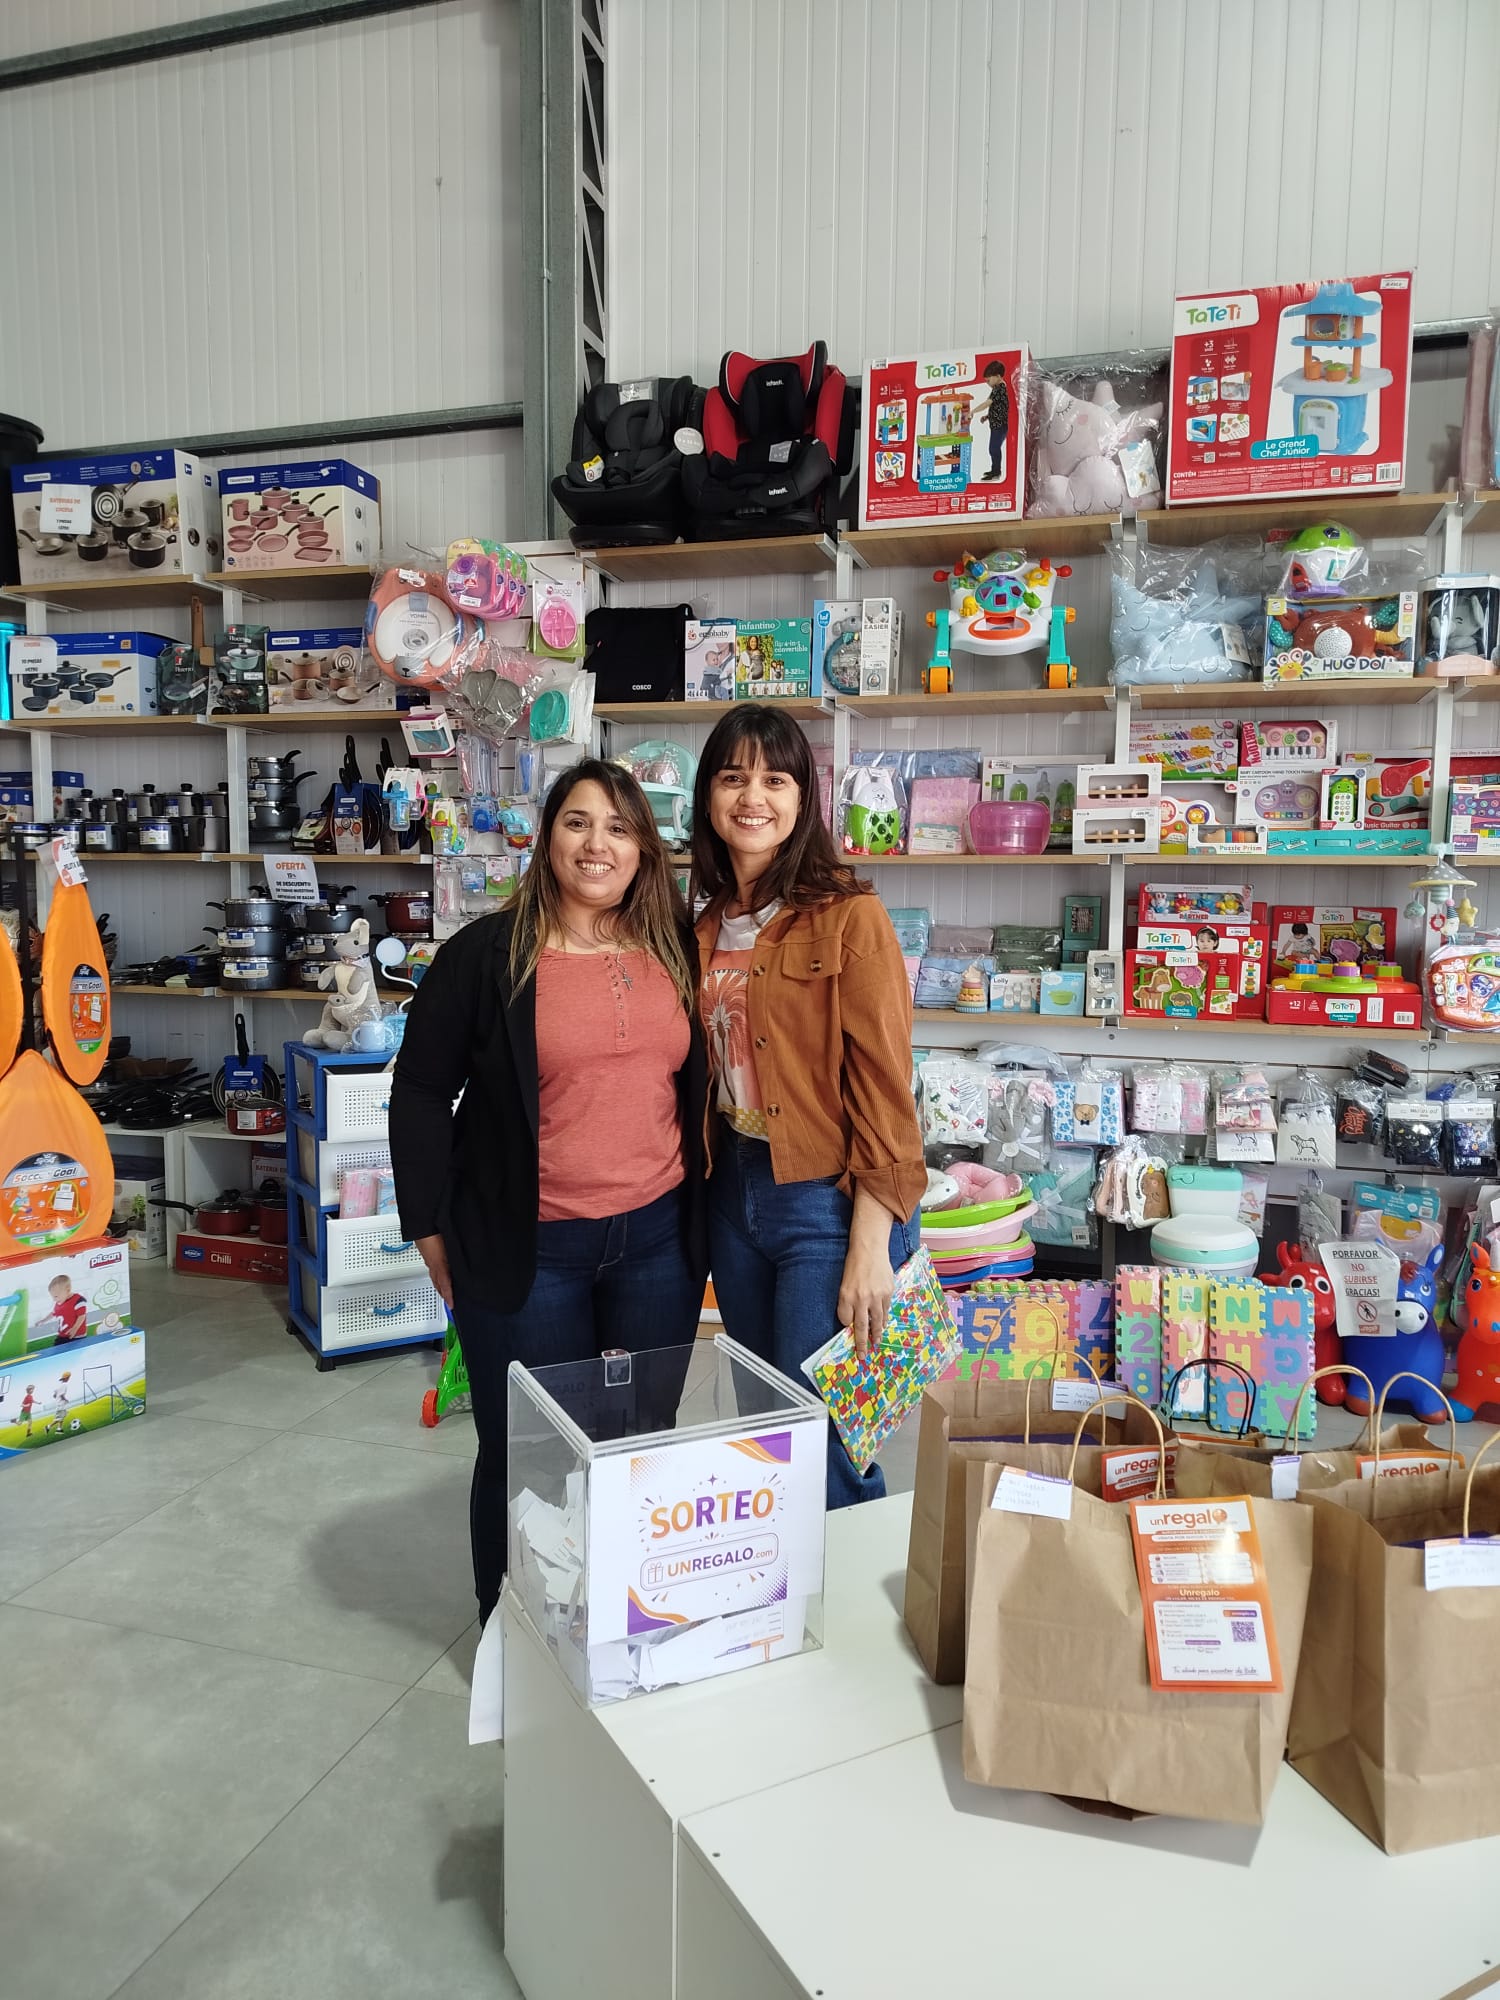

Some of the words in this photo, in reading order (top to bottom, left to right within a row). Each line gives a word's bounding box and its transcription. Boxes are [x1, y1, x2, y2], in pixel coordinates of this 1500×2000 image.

[1186, 303, 1241, 325] TaTeTi
[925, 362, 967, 379] TaTeTi
[1265, 441, 1277, 450] Le
[1278, 438, 1306, 449] Grand
[1260, 447, 1281, 458] Chef
[924, 477, 953, 486] Bancada
[954, 476, 964, 484] de
[929, 483, 958, 491] Trabalho
[739, 620, 776, 631] infantino
[1322, 657, 1355, 671] HUG
[631, 683, 652, 691] cosco
[1243, 722, 1262, 766] CARTOON
[275, 862, 306, 870] OFERTA
[1146, 933, 1181, 944] TaTeTi
[1172, 956, 1192, 964] TaTeTi
[1331, 1003, 1355, 1011] TaTeTi
[54, 1167, 77, 1178] Goal
[91, 1252, 121, 1267] pilsan
[210, 1253, 232, 1265] Chilli
[1332, 1250, 1379, 1259] PORFAVOR
[1351, 1263, 1365, 1271] NO
[1344, 1275, 1377, 1284] SUBIRSE
[1345, 1288, 1380, 1297] GRACIAS!
[1225, 1296, 1250, 1323] N
[972, 1308, 1002, 1343] 5
[1025, 1309, 1056, 1343] 6
[1129, 1322, 1155, 1354] 2
[1378, 1462, 1440, 1478] regalo
[650, 1487, 774, 1539] SORTEO
[1150, 1508, 1228, 1528] unregalo
[667, 1547, 774, 1578] UNREGALO.com
[1180, 1588, 1220, 1597] Unregalo
